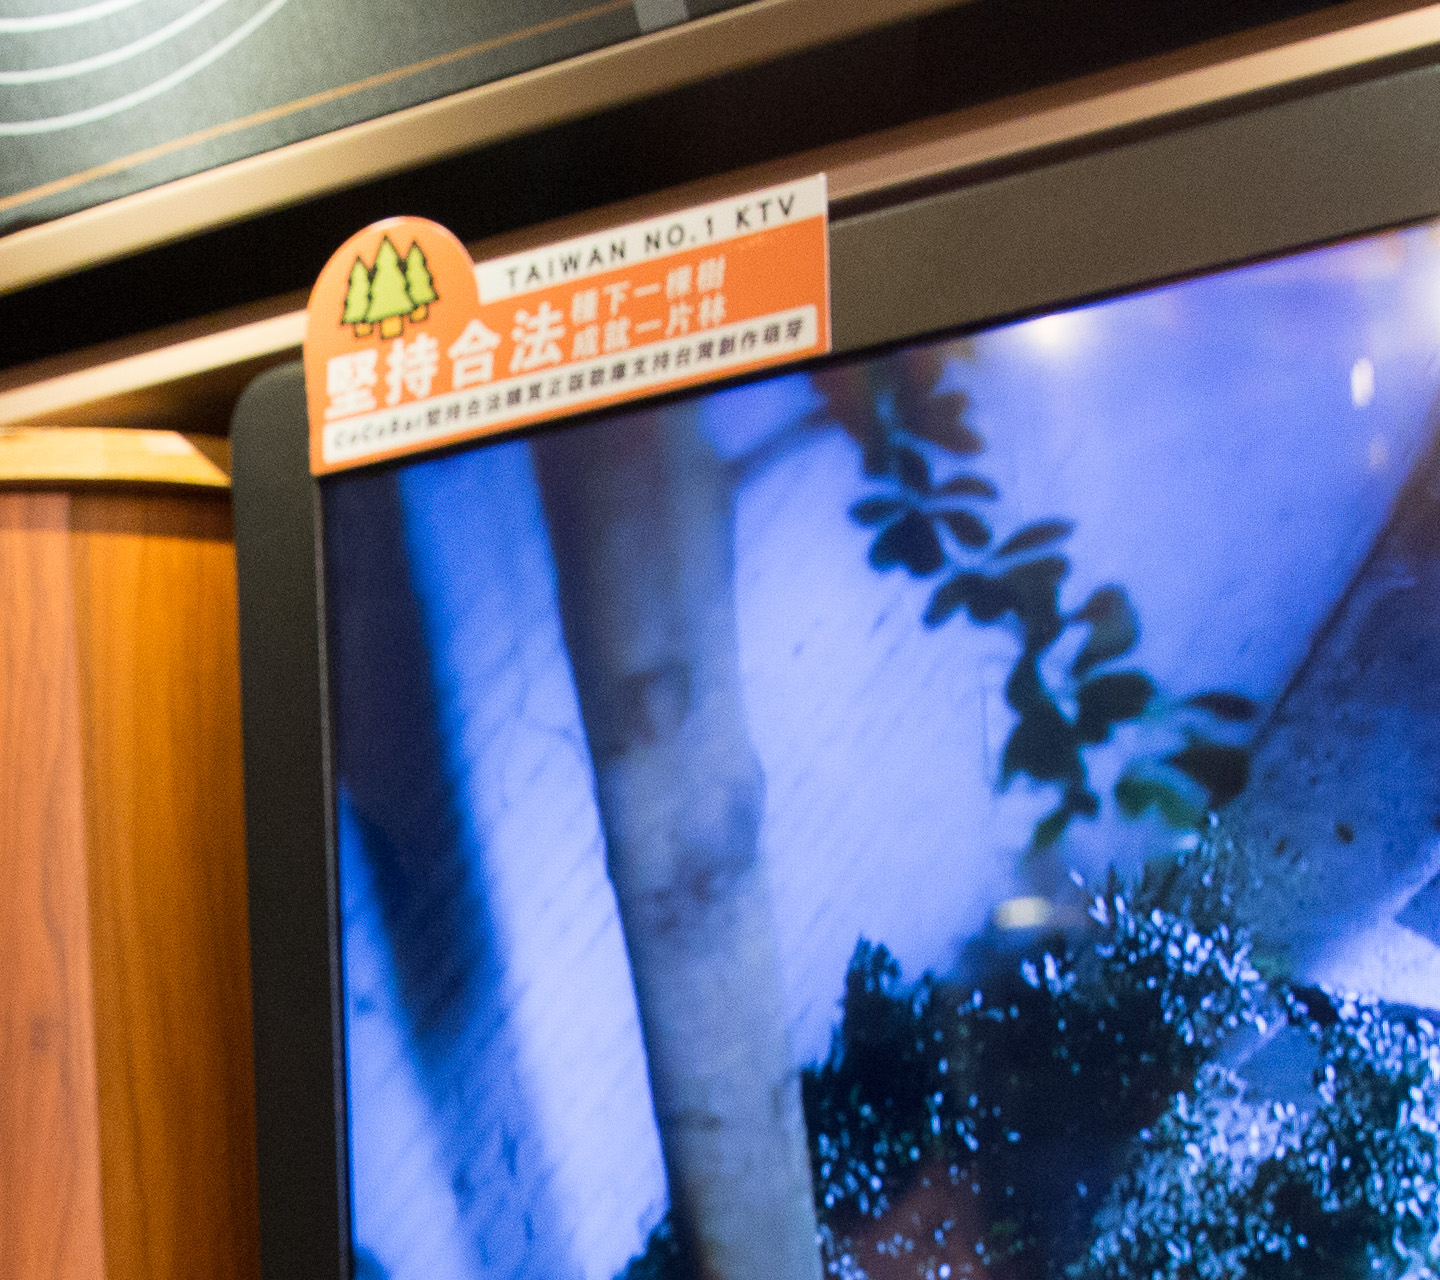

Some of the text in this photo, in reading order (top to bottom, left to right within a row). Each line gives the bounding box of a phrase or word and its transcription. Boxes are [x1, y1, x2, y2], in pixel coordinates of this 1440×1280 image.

[506, 193, 798, 290] TAIWAN NO.1 KTV
[570, 256, 727, 321] 種下一棵樹
[570, 292, 728, 362] 成就一片林
[323, 308, 564, 420] 堅持合法
